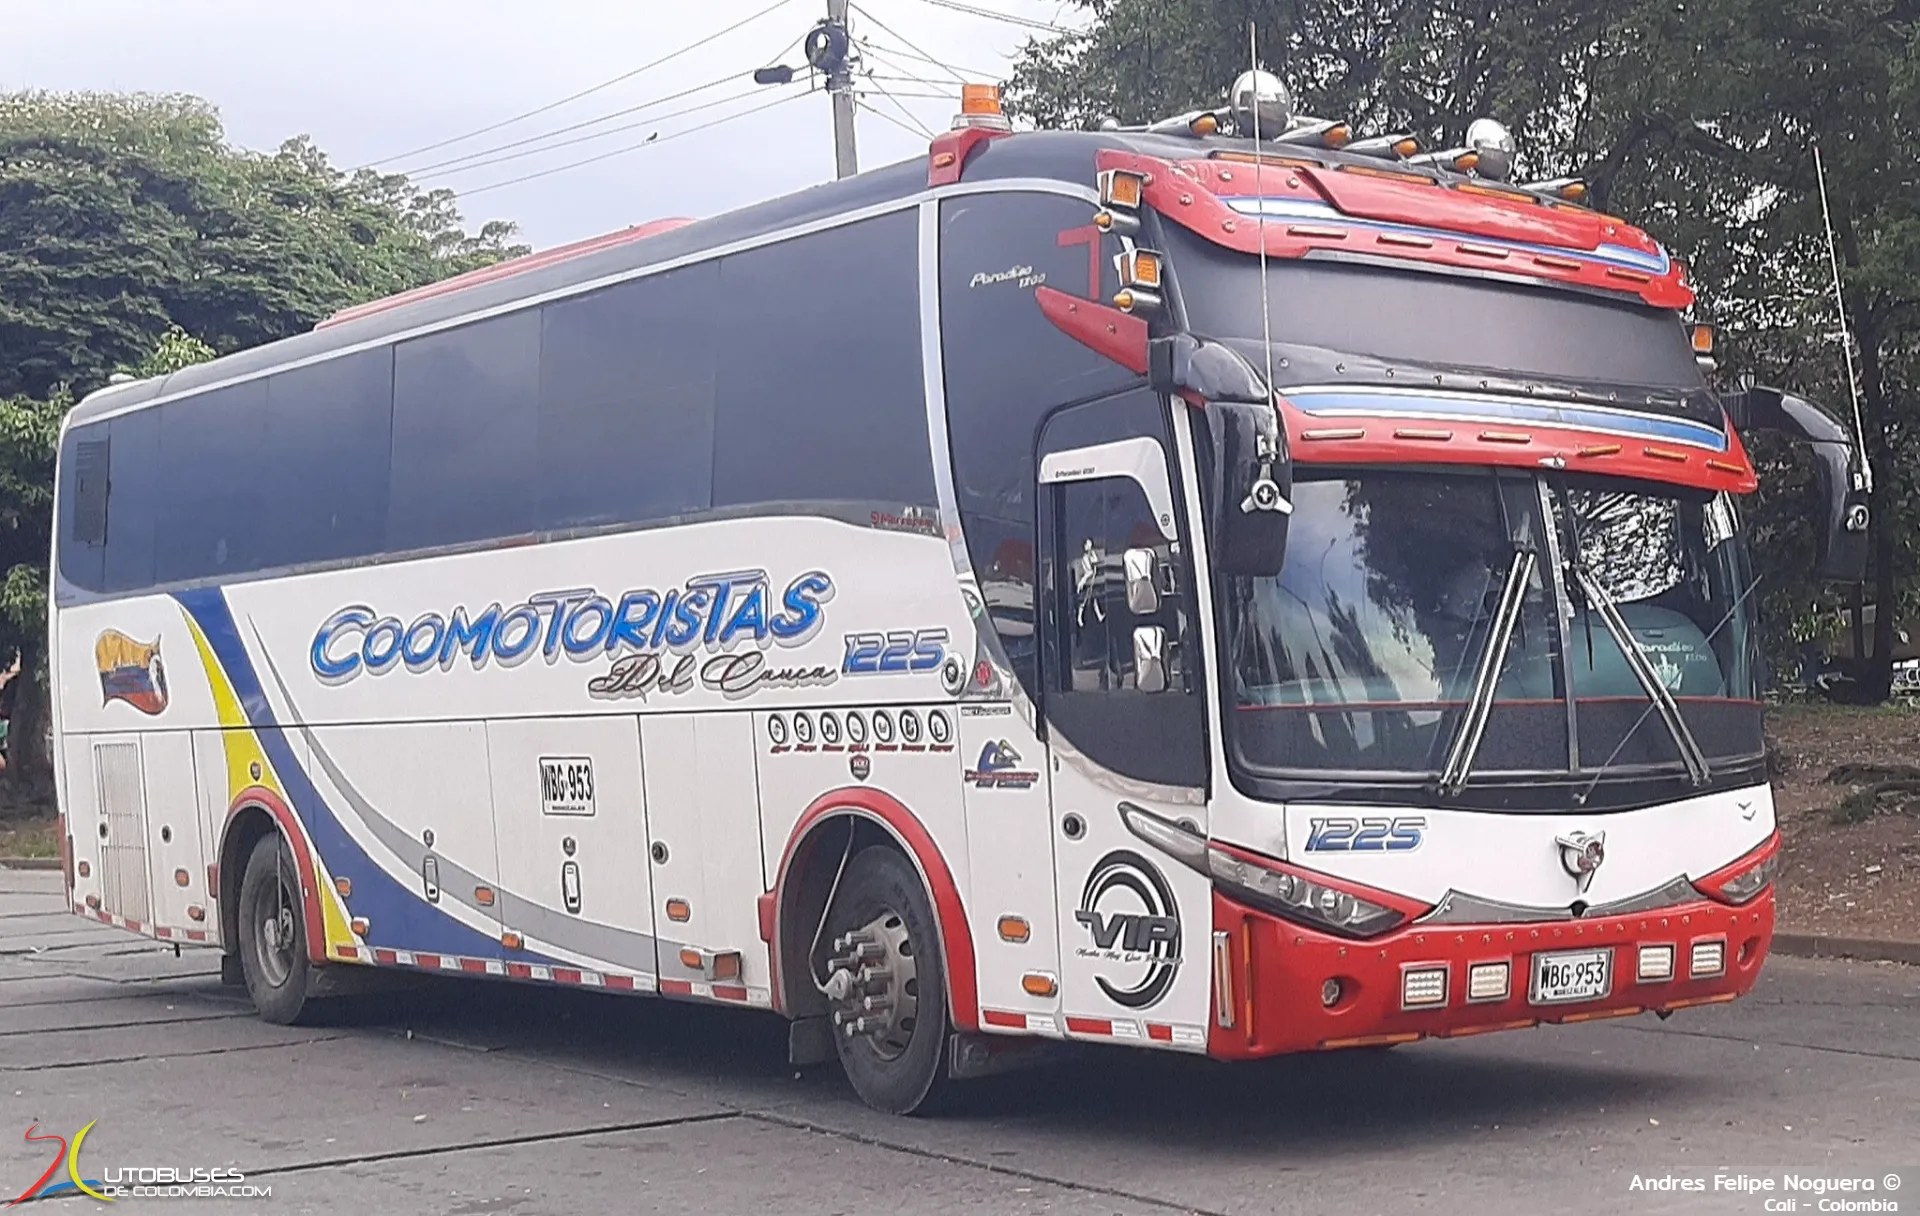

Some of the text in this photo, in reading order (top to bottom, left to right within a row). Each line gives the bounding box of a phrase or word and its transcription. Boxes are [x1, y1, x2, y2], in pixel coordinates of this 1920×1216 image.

[310, 569, 835, 687] COOMOTORISTAS
[842, 628, 950, 676] 1225
[588, 650, 838, 703] Del Cauca
[1304, 816, 1428, 853] 1225
[1075, 910, 1178, 952] VIP
